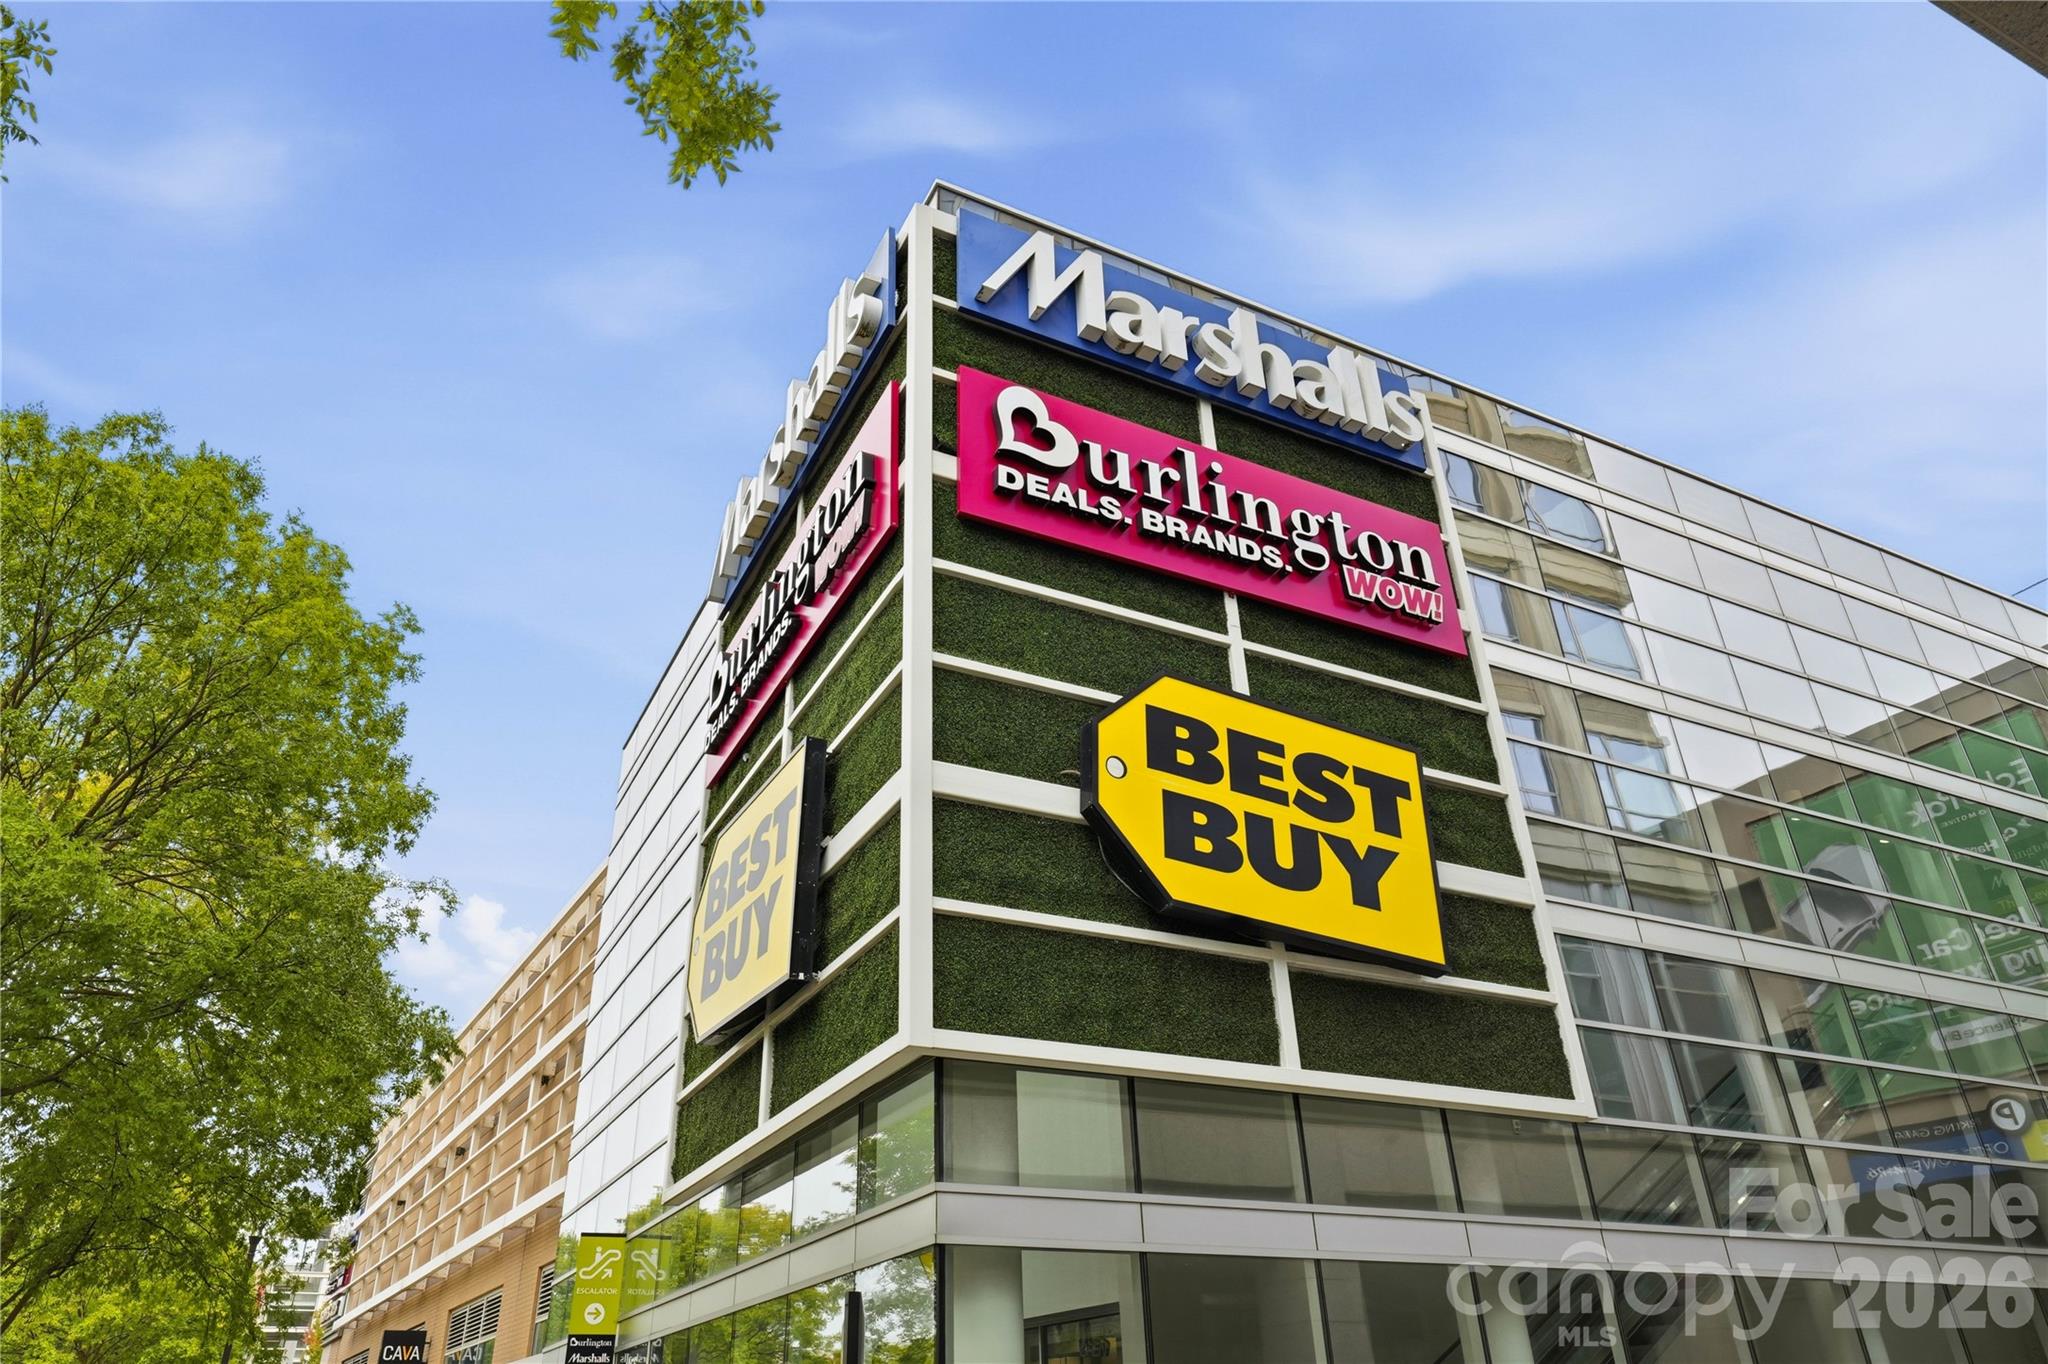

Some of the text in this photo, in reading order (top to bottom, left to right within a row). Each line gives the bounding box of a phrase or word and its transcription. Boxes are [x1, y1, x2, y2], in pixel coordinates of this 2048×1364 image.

[975, 229, 1425, 451] Marshalls
[707, 270, 885, 602] Marshalls
[995, 385, 1441, 588] Burlington
[994, 463, 1294, 574] DEALS. BRANDS.
[707, 450, 874, 723] Burlington
[1343, 563, 1445, 627] WOW!
[741, 611, 793, 697] BRANDS.
[1145, 704, 1412, 839] BEST
[704, 785, 799, 932] BEST
[1162, 789, 1400, 912] BUY
[701, 874, 784, 1004] BUY
[382, 1345, 421, 1361] CAVA
[569, 1337, 612, 1349] Burlington
[576, 1287, 618, 1296] ESCALATOR
[568, 1352, 611, 1363] Marshalls
